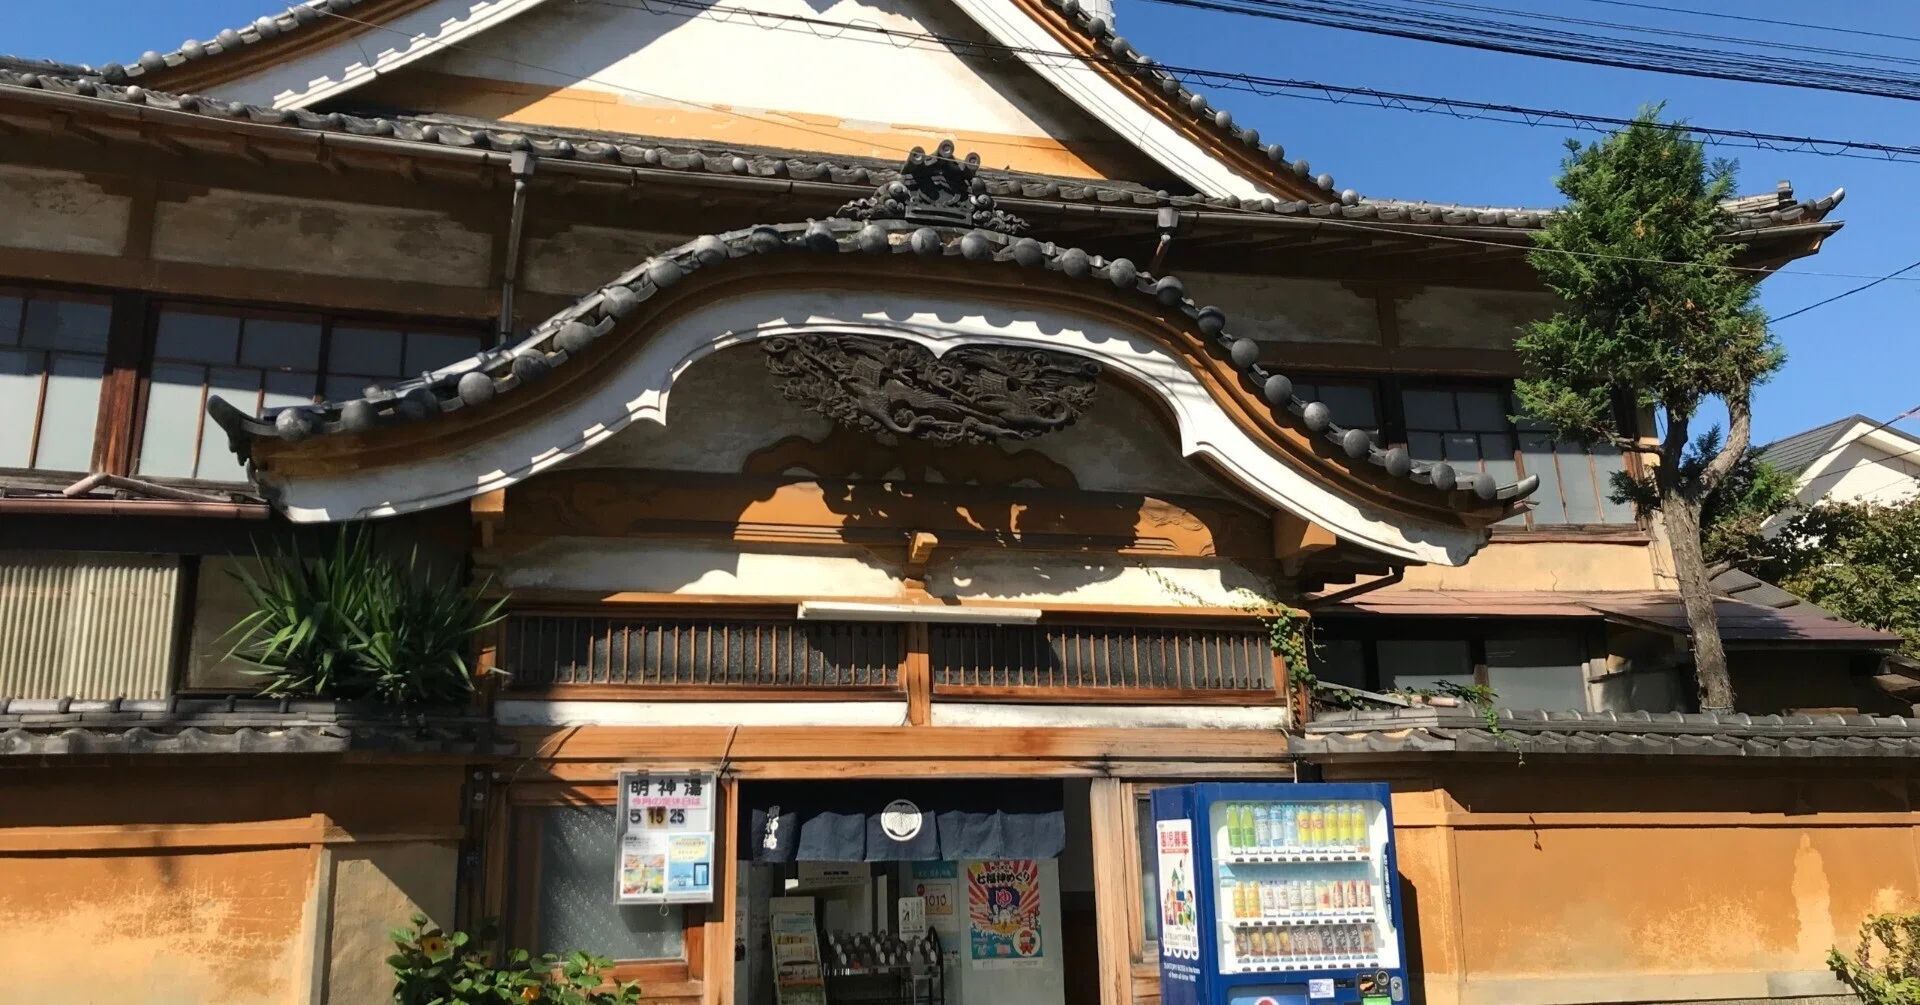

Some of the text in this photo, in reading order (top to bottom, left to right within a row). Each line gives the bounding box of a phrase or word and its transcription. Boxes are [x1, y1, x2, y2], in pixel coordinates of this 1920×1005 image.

[631, 779, 702, 796] 明神湯
[632, 797, 701, 806] 今月の定休日は
[630, 807, 685, 824] 5 15 25
[976, 870, 1030, 885] 七福神めぐり
[925, 894, 947, 906] 1010
[995, 889, 1012, 907] ゆ
